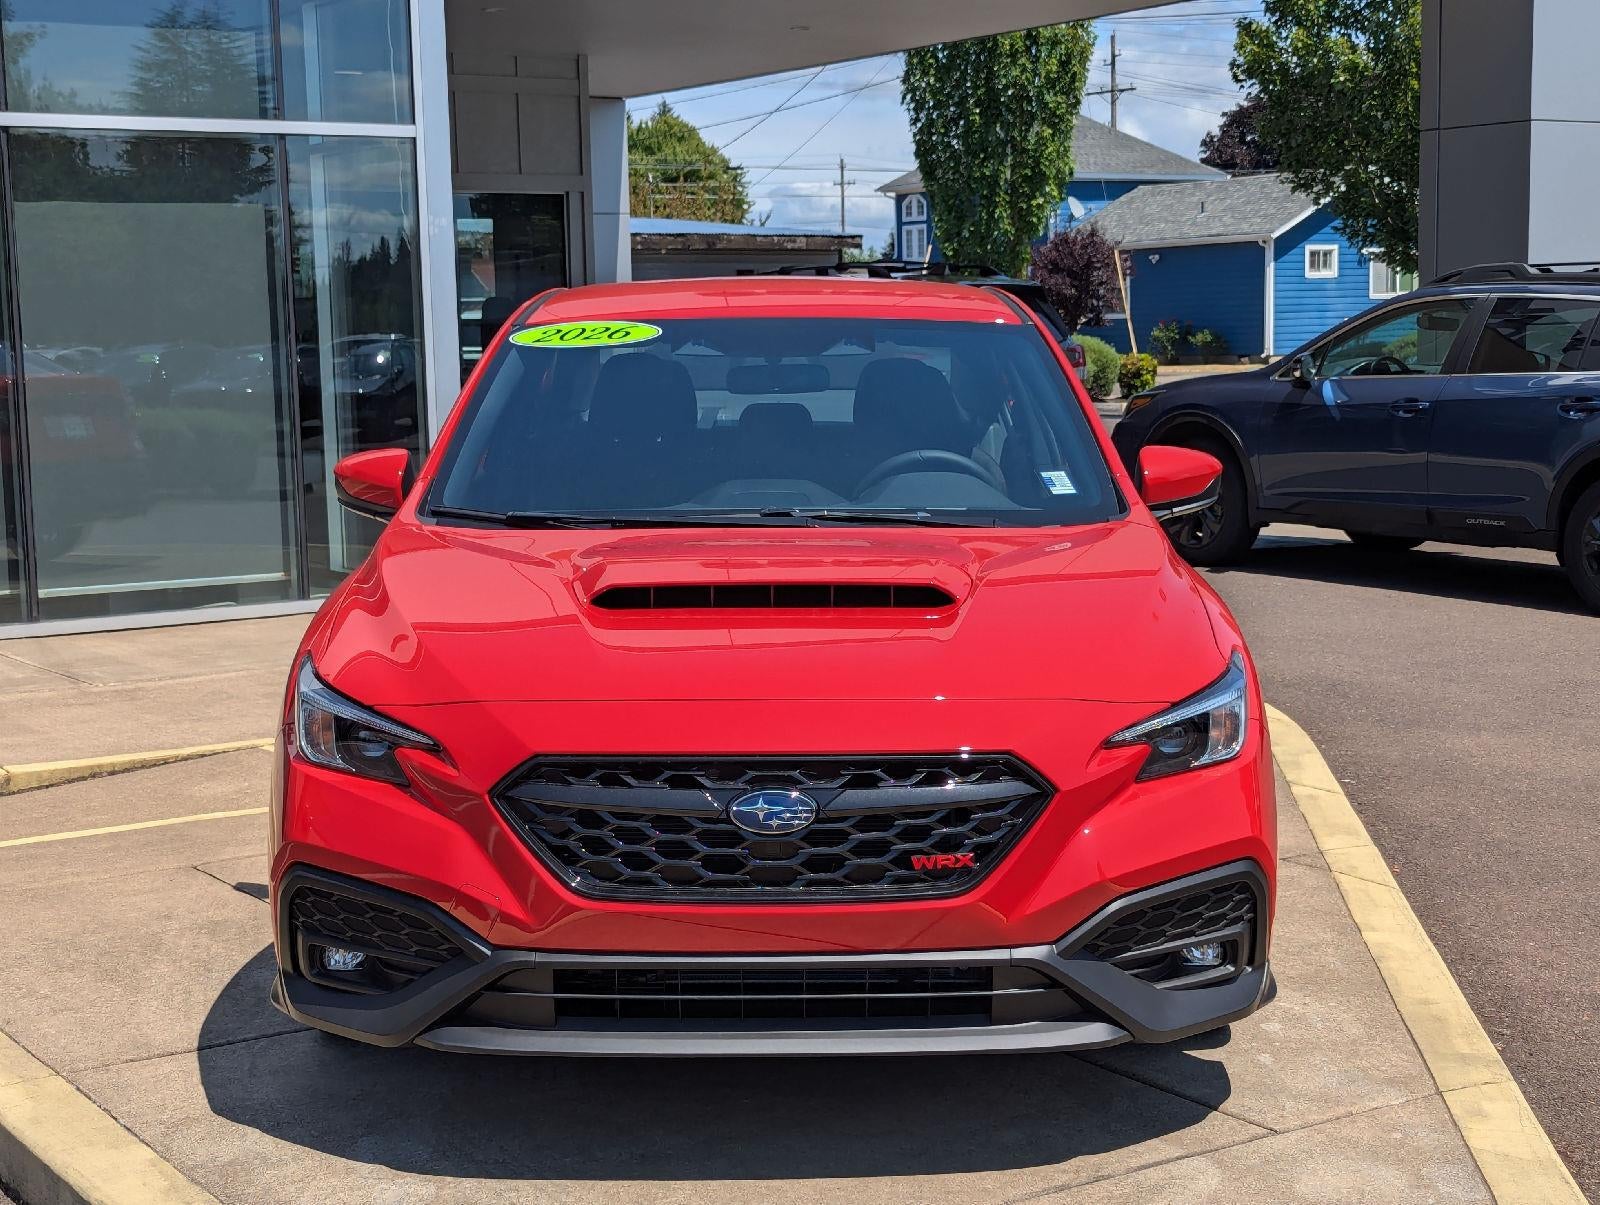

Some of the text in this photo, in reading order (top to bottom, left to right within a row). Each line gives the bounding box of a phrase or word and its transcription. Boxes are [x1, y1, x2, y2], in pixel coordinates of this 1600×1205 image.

[532, 325, 640, 343] 2026
[1466, 518, 1506, 526] OUTBACK
[911, 852, 975, 870] WRX
